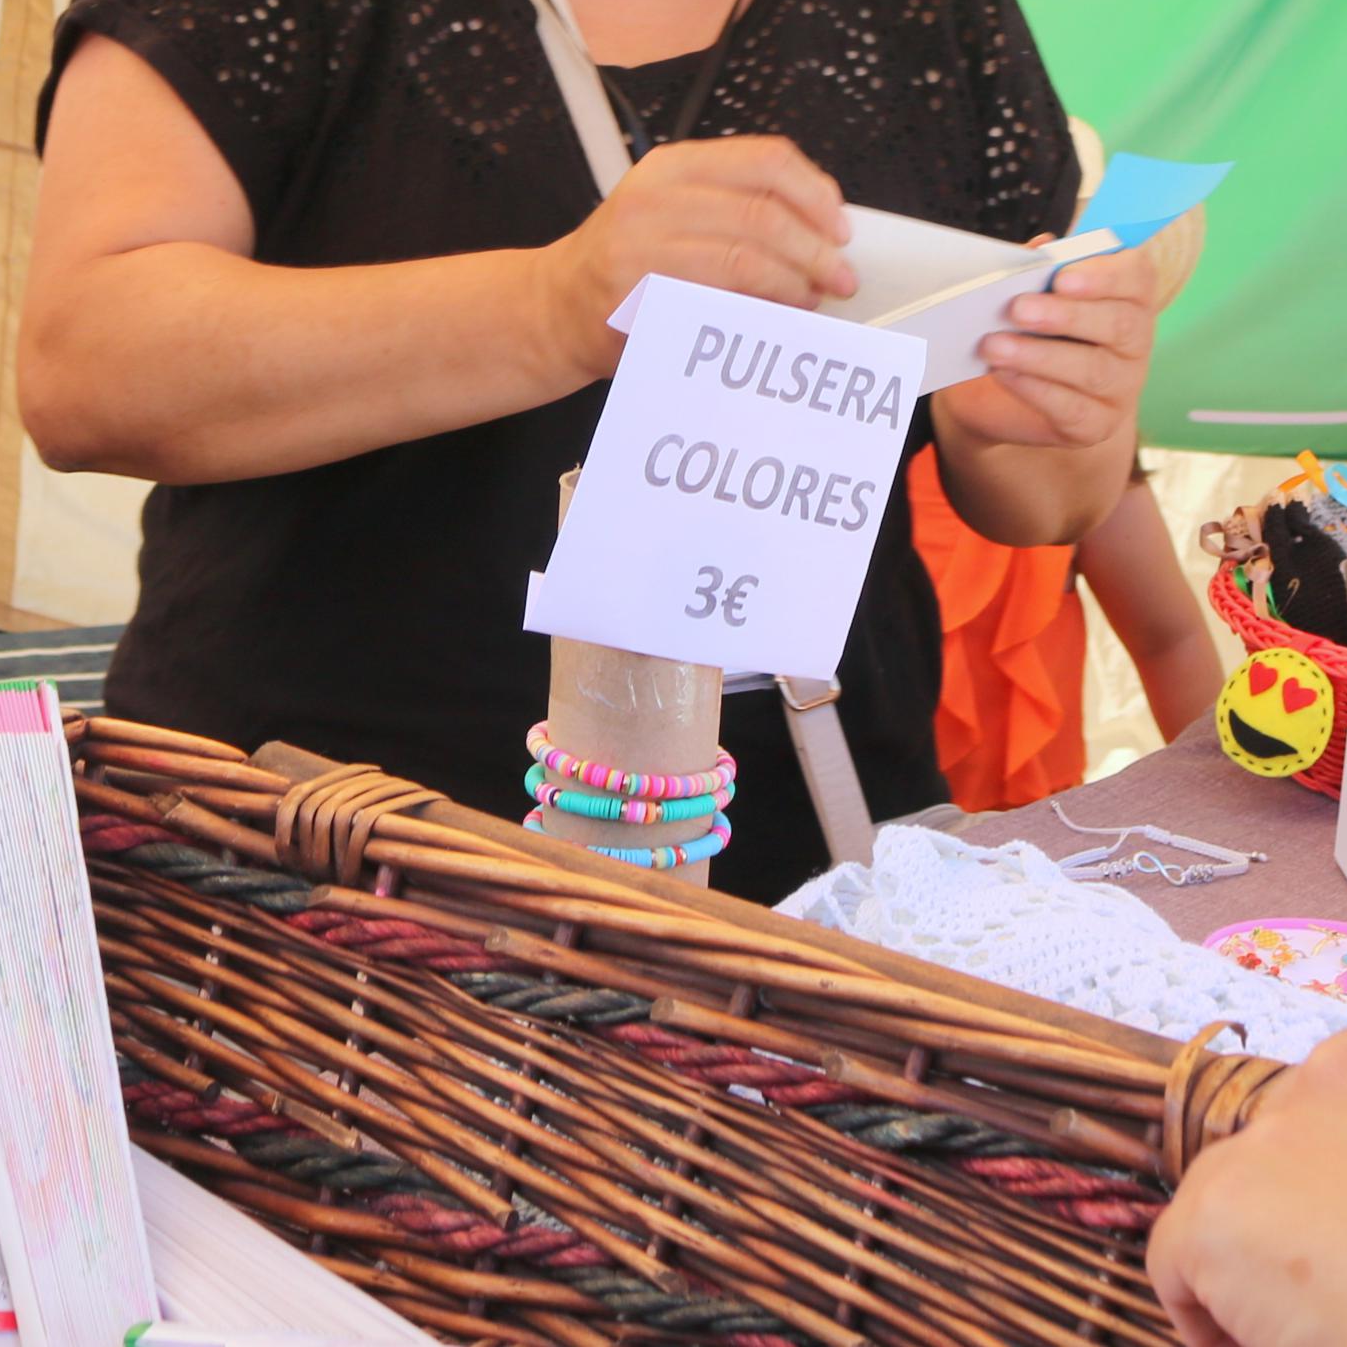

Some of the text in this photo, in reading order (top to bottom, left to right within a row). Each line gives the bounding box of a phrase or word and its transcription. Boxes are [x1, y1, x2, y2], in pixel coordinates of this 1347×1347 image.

[684, 324, 902, 431] PULSERA
[644, 434, 877, 532] COLORES
[684, 565, 760, 628] 3€
